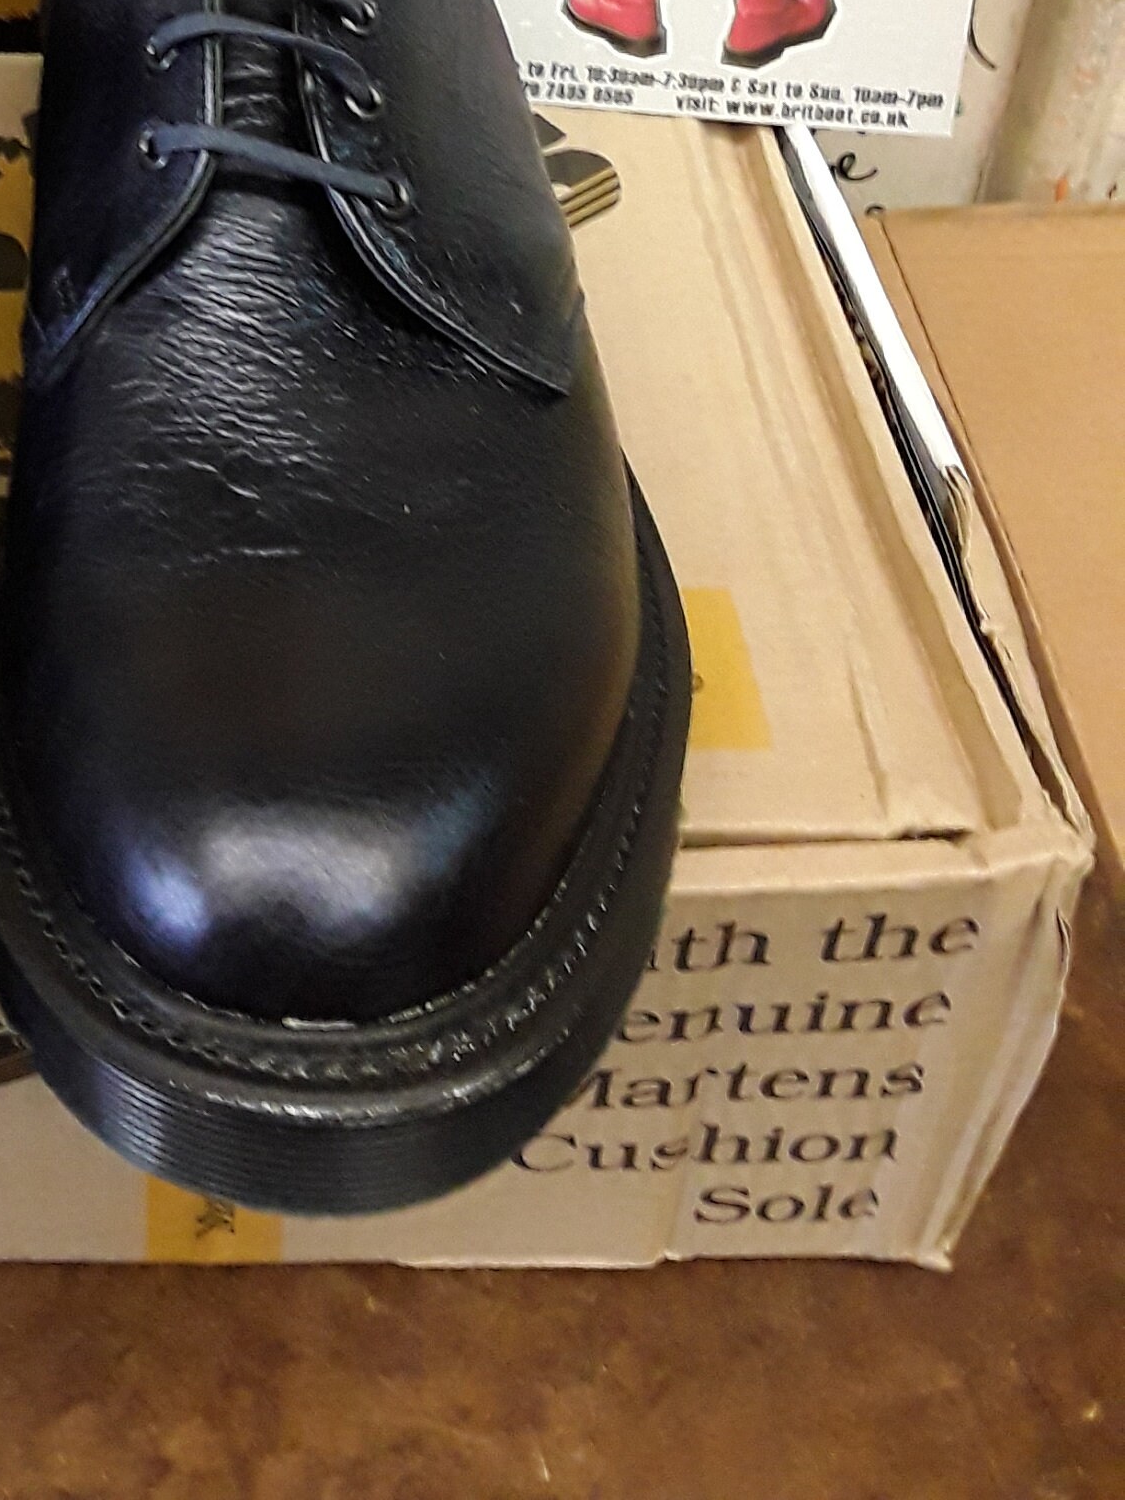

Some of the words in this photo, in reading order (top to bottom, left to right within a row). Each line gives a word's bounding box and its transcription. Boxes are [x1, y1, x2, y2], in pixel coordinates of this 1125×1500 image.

[786, 80, 803, 99] to
[817, 912, 980, 965] the
[615, 990, 953, 1045] enuine
[509, 1121, 899, 1175] Cushion
[691, 1183, 881, 1227] Sole
